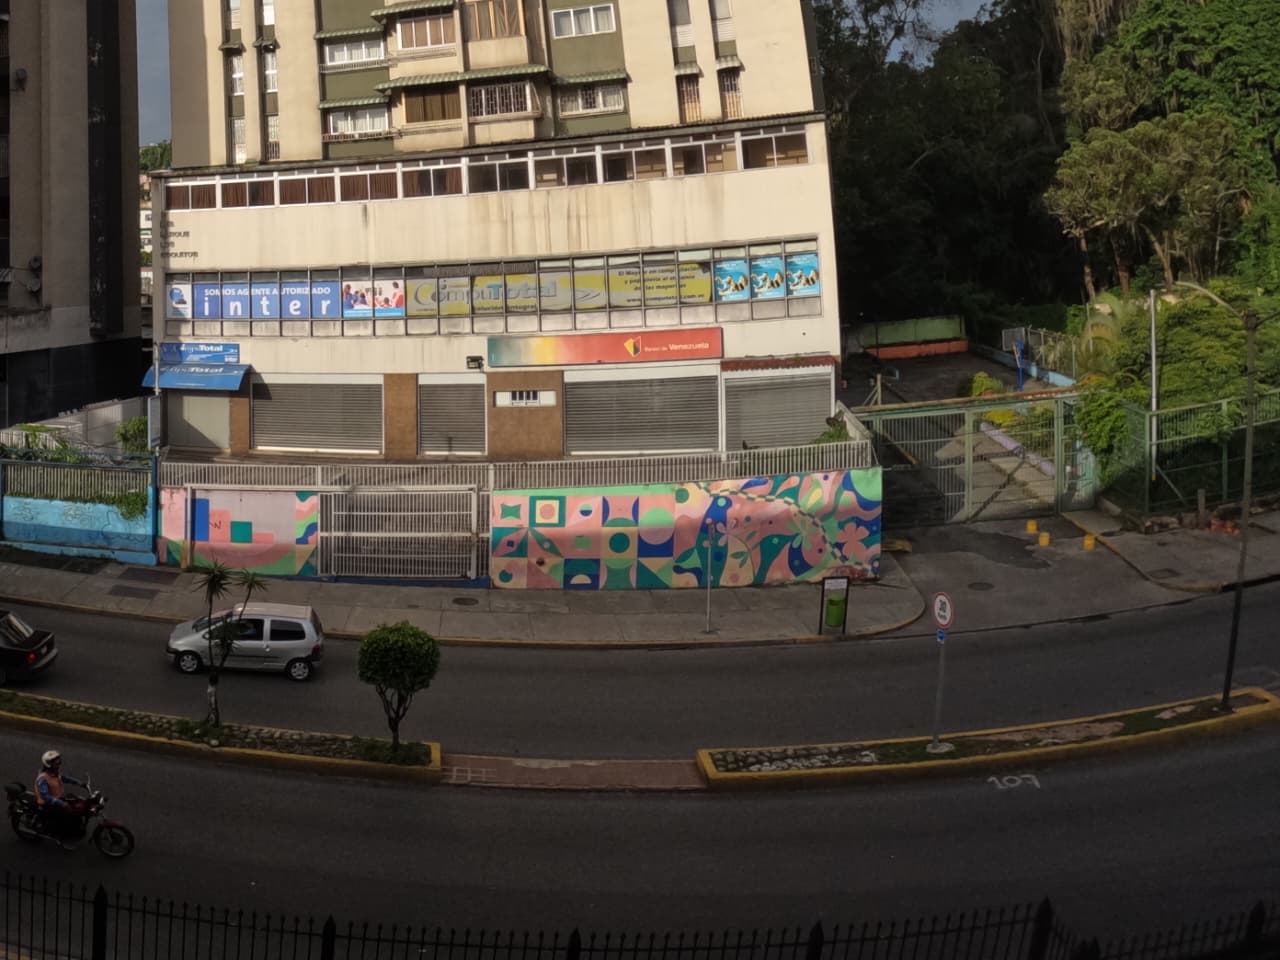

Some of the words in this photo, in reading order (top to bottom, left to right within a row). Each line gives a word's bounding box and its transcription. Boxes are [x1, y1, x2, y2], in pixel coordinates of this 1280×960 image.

[204, 288, 236, 297] SOMOS
[236, 288, 270, 296] AGENTE
[271, 286, 331, 296] AUTORIZADO
[203, 296, 332, 317] inter
[669, 342, 710, 351] Venezuela
